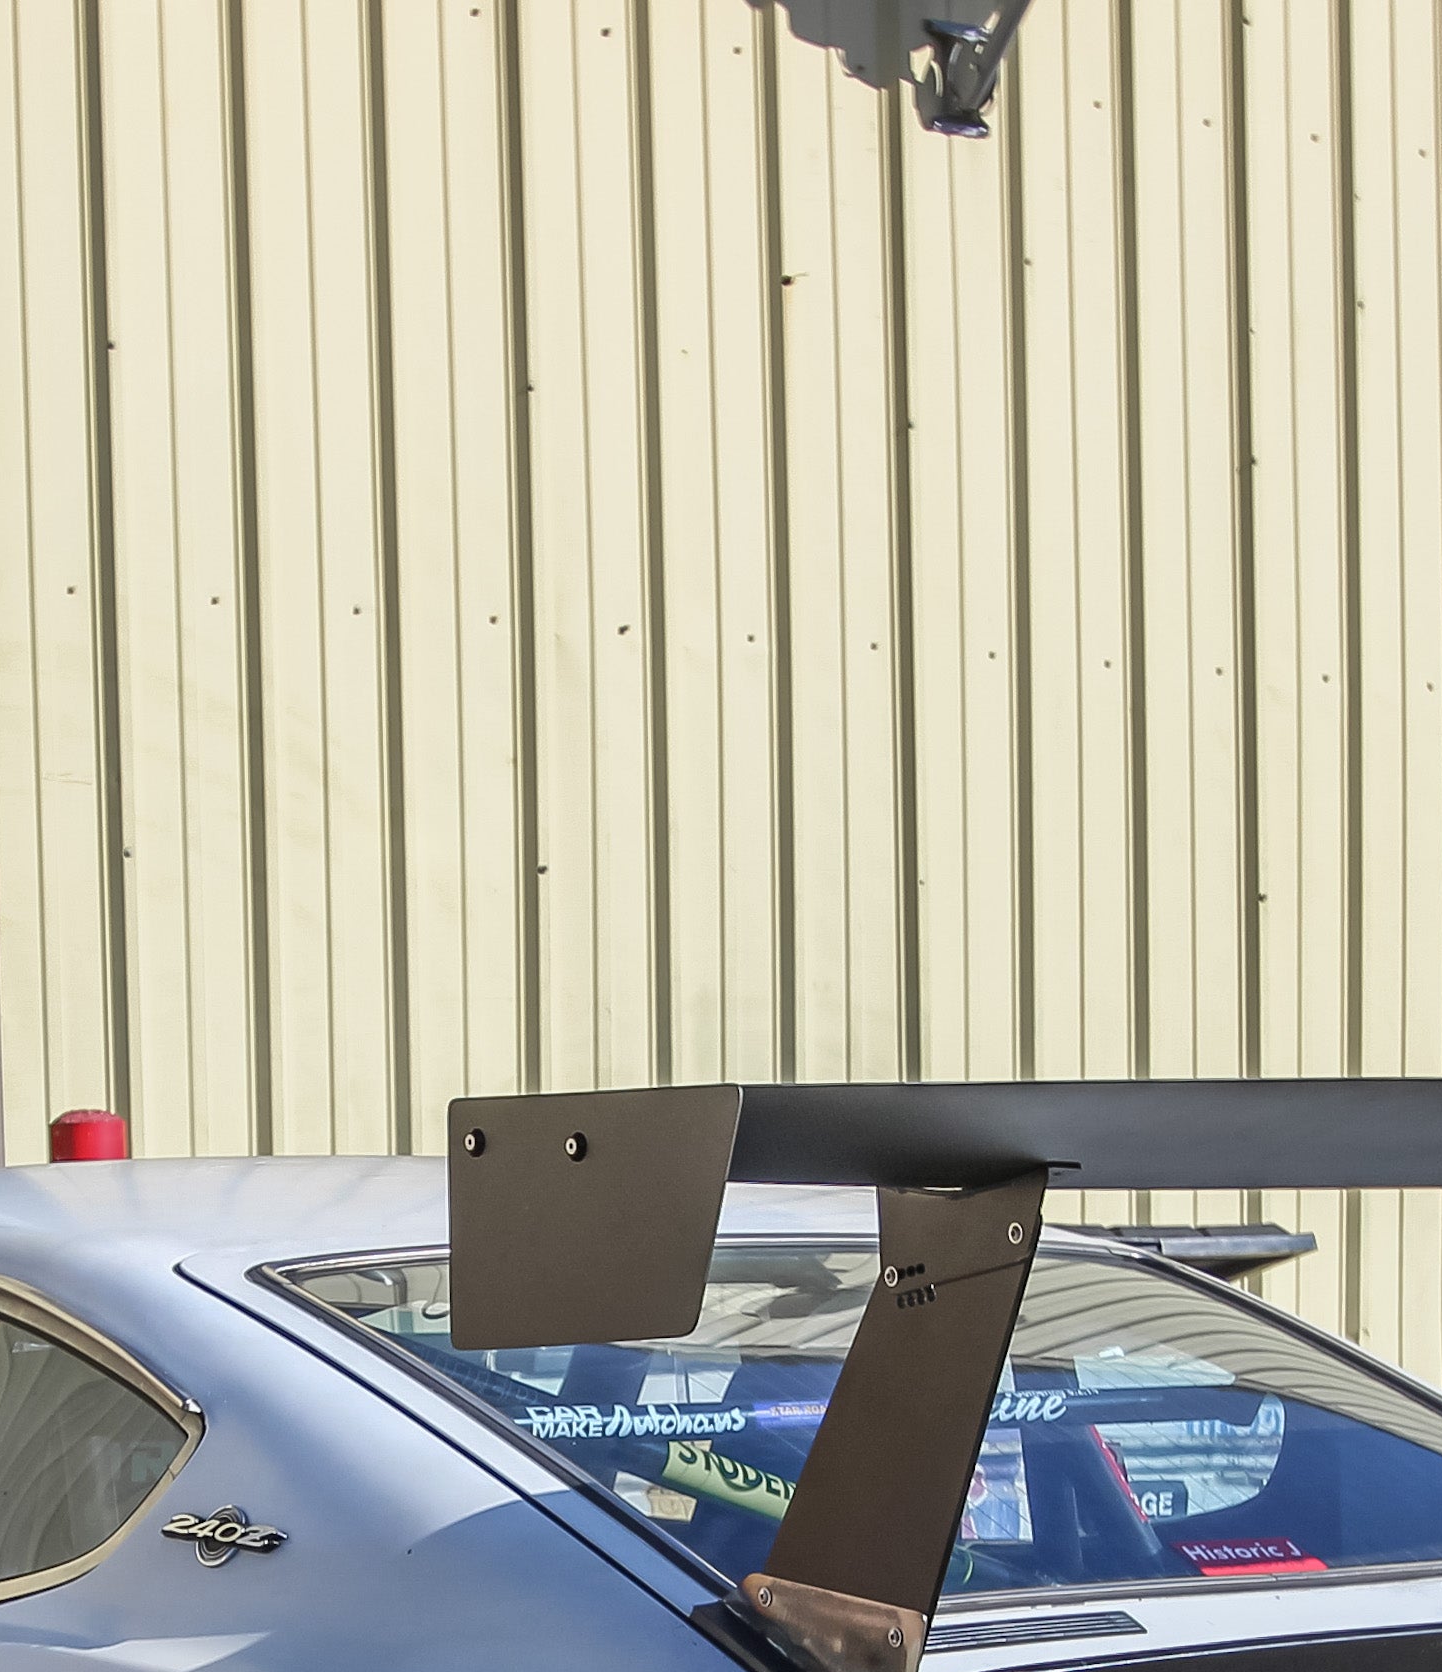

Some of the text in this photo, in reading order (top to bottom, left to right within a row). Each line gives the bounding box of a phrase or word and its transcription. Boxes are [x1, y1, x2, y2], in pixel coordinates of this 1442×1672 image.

[532, 1420, 604, 1438] MAKE
[1133, 1491, 1173, 1517] GE
[1182, 1541, 1284, 1561] Historic
